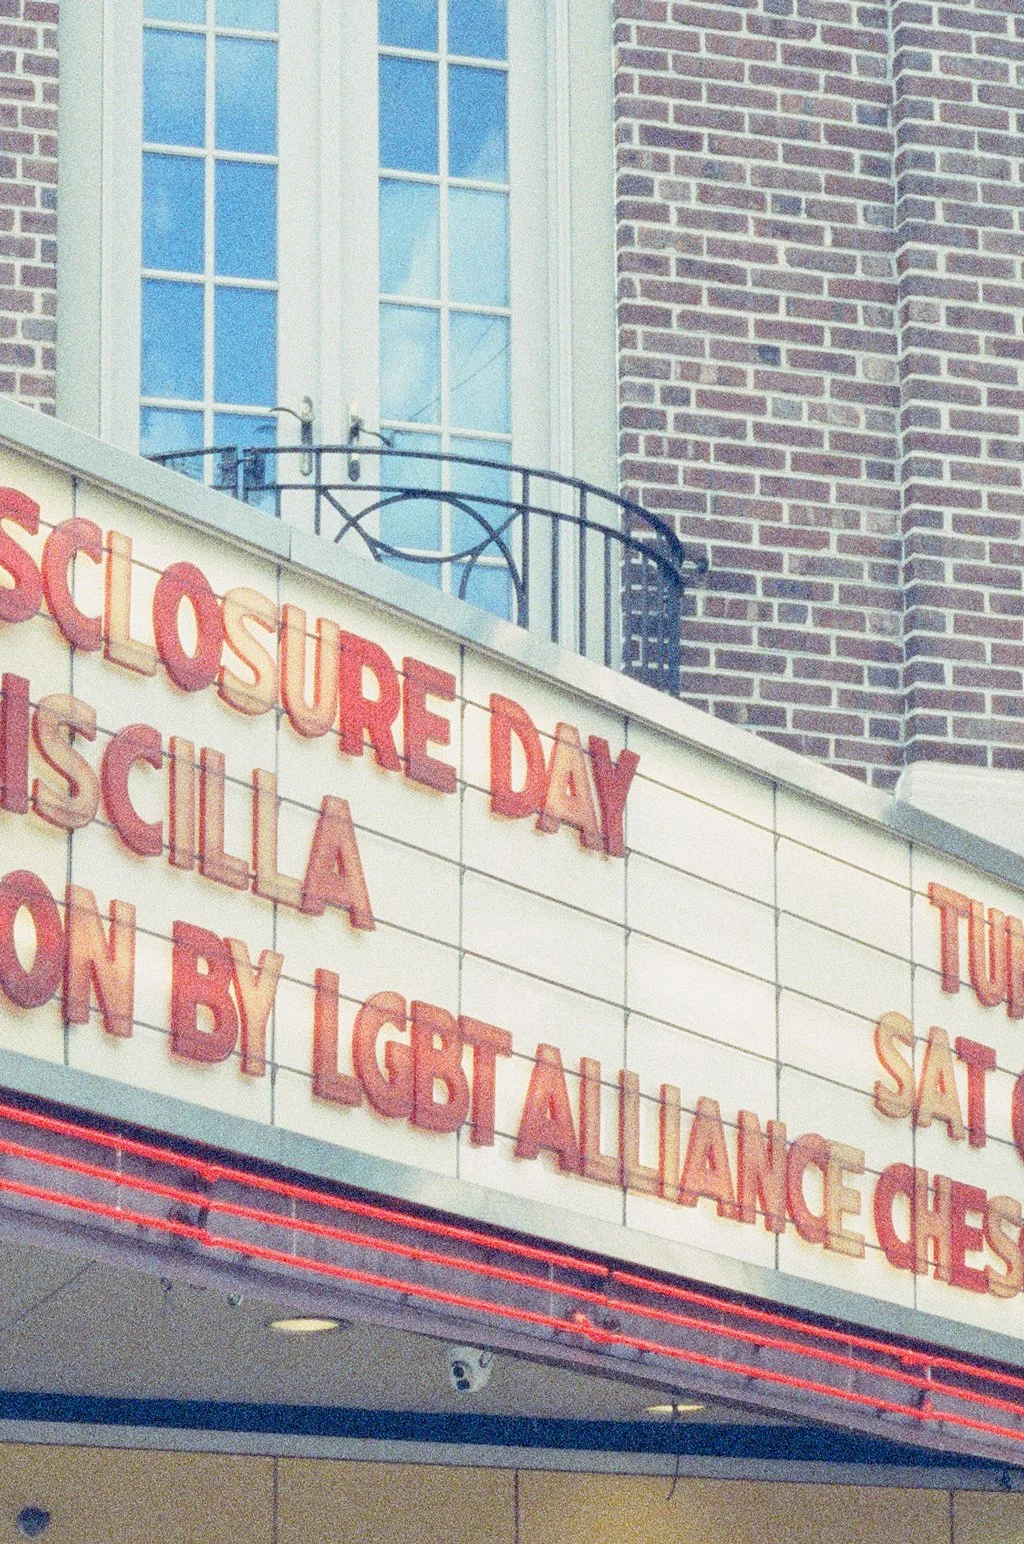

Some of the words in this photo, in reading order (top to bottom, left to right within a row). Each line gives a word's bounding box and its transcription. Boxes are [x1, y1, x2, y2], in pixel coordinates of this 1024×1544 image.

[489, 692, 641, 858] DAY
[170, 919, 284, 1077] BY
[312, 968, 513, 1147] LGBT
[513, 1042, 866, 1259] ALLIANCE
[873, 1162, 1024, 1299] CHES
[873, 1010, 997, 1149] SAT
